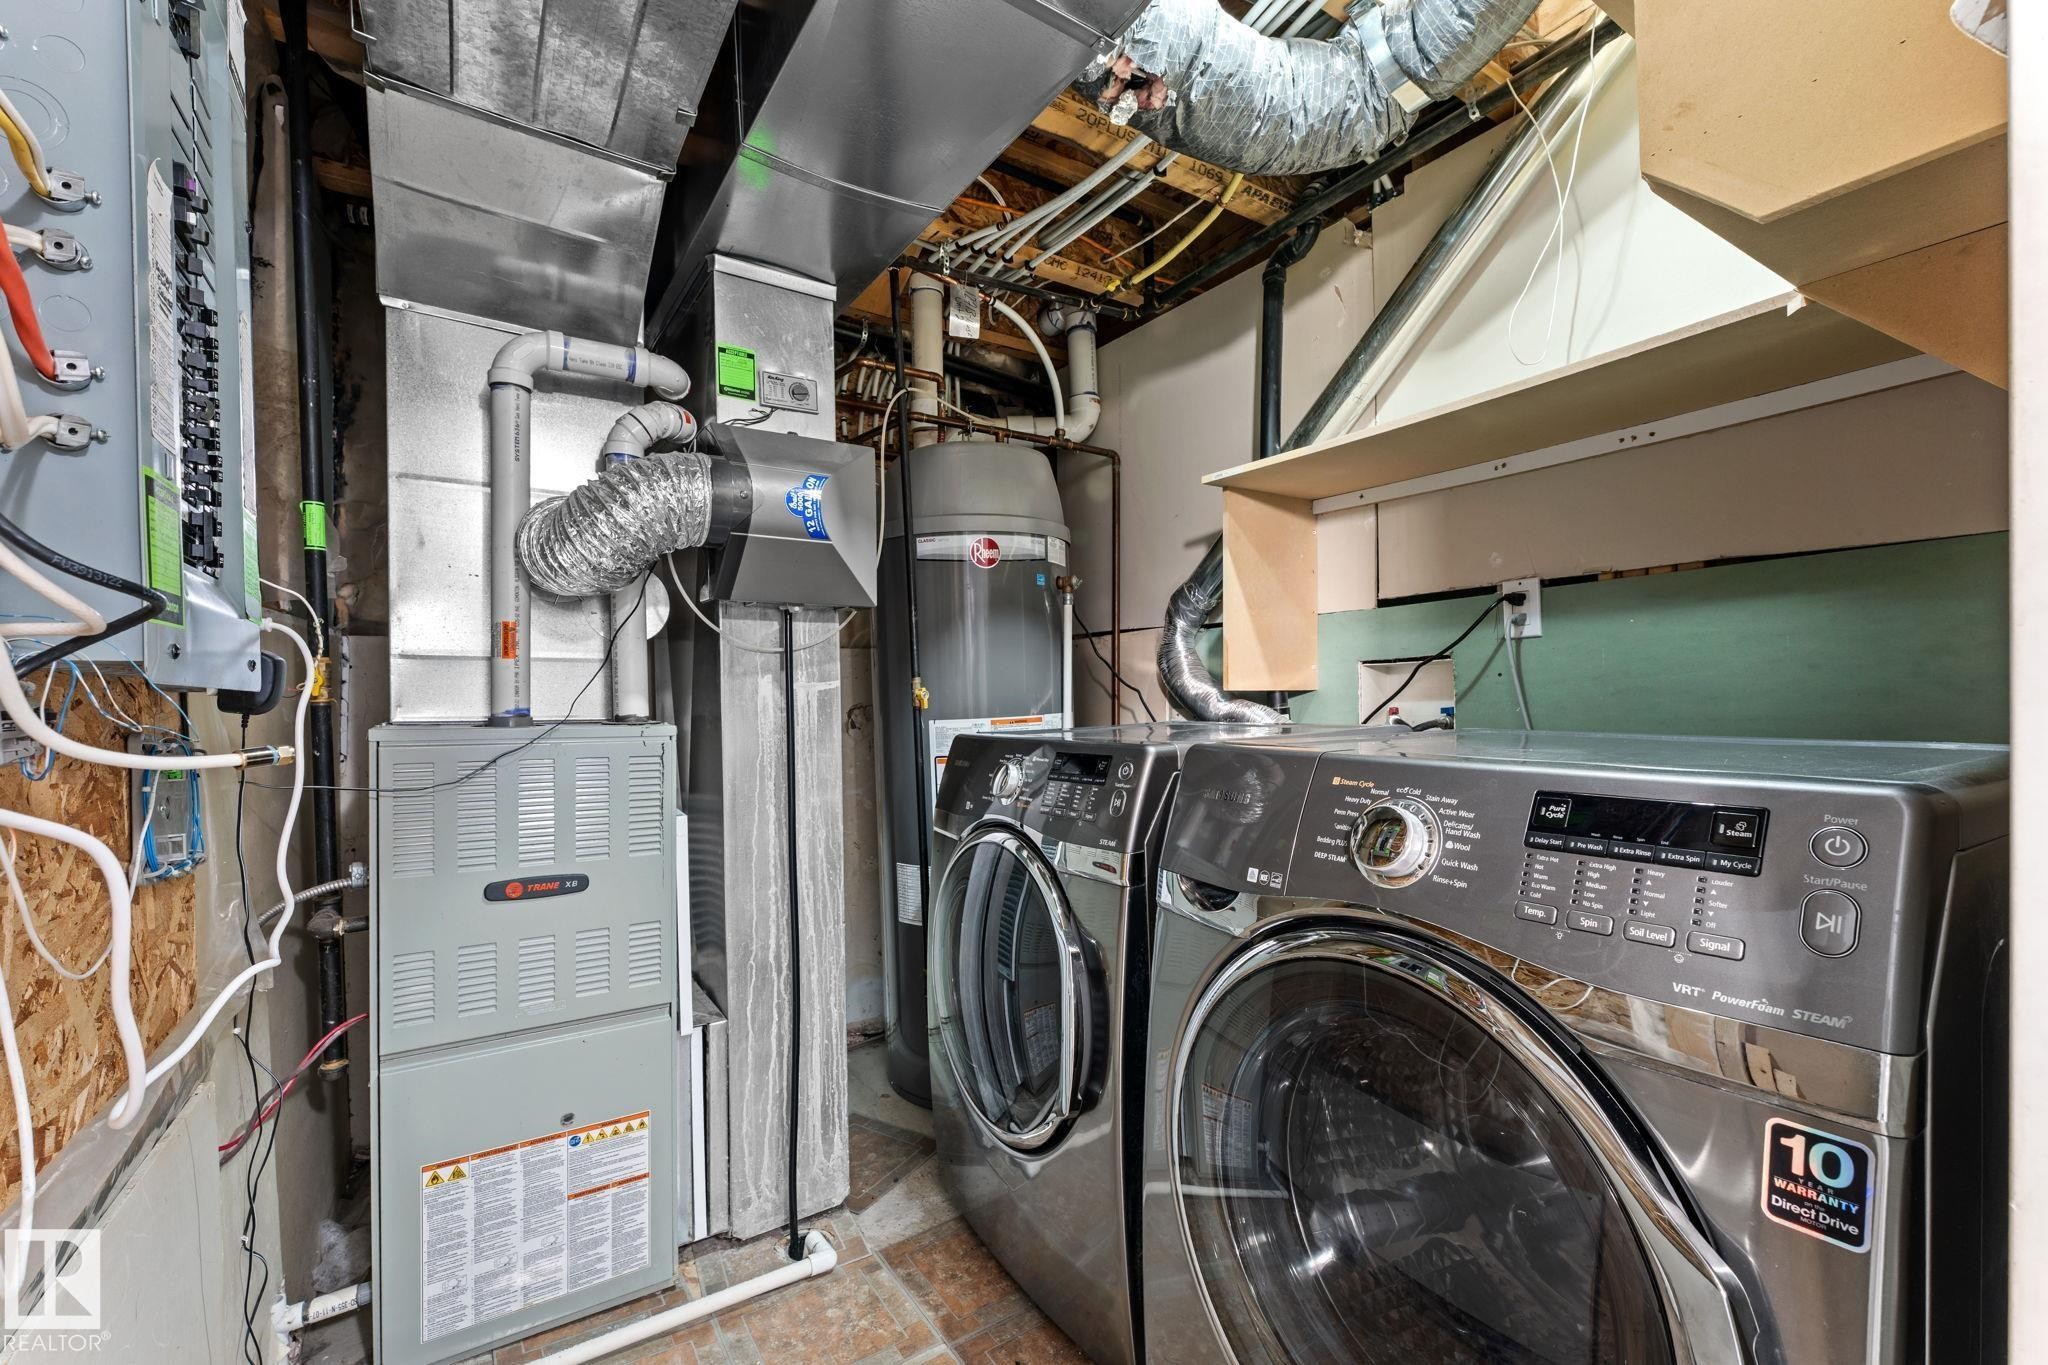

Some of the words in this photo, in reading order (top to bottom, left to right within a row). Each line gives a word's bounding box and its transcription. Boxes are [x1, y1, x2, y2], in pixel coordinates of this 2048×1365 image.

[806, 520, 816, 532] 12
[974, 542, 1000, 564] Rheem
[1340, 778, 1358, 786] Steam
[1359, 780, 1375, 788] Cycle
[1370, 788, 1390, 796] Normal
[1409, 788, 1422, 796] Cold
[1344, 796, 1359, 804] Heavy
[1360, 797, 1372, 805] Duty
[1425, 794, 1440, 802] Stain
[1441, 796, 1458, 805] Away
[1334, 808, 1348, 816] Perm
[1548, 804, 1566, 812] Pure
[1438, 808, 1456, 816] Active
[1457, 810, 1476, 819] Wear
[1824, 814, 1858, 826] Power
[1445, 828, 1462, 837] Hand
[1463, 830, 1481, 840] Wash
[1726, 829, 1752, 838] Steam
[1099, 838, 1117, 847] STEAM
[1316, 835, 1335, 846] Bedding
[1534, 836, 1549, 845] Delay
[1550, 838, 1562, 846] Start
[1453, 842, 1471, 851] Wool
[1587, 843, 1603, 851] Wash
[1619, 847, 1634, 855] Extra
[1635, 848, 1651, 856] Rinse
[1314, 851, 1328, 860] DEEP
[1328, 853, 1348, 863] STEAM
[1667, 853, 1684, 861] Extra
[1685, 855, 1700, 863] Spin
[1441, 858, 1460, 868] Quick
[1460, 860, 1479, 871] Wash
[1720, 859, 1732, 867] My
[1732, 861, 1752, 869] Cycle
[1647, 869, 1665, 878] Heavy
[1432, 874, 1467, 888] Rinse+Spin
[1585, 881, 1608, 890] Medium
[1711, 880, 1734, 888] Louder
[1803, 874, 1868, 892] Start/Pause
[527, 882, 560, 892] TRANE
[1644, 890, 1665, 899] Normal
[1592, 902, 1603, 910] Spin
[1708, 900, 1728, 909] Softer
[1524, 906, 1546, 918] Temp.
[1640, 909, 1656, 918] Light
[1580, 917, 1598, 928] Spin
[1630, 926, 1644, 937] Soil
[1646, 929, 1667, 942] Level
[1700, 938, 1730, 952] Signal
[1711, 990, 1785, 1016] PowerFoam
[1792, 1009, 1848, 1029] STEAM
[1780, 1134, 1854, 1188] 10
[1798, 1178, 1834, 1195] YEAR
[1773, 1176, 1860, 1215] WARRANTY
[1814, 1204, 1825, 1212] the
[1771, 1194, 1817, 1220] Direct
[1818, 1211, 1860, 1236] Drive
[1800, 1216, 1827, 1230] MOTOR
